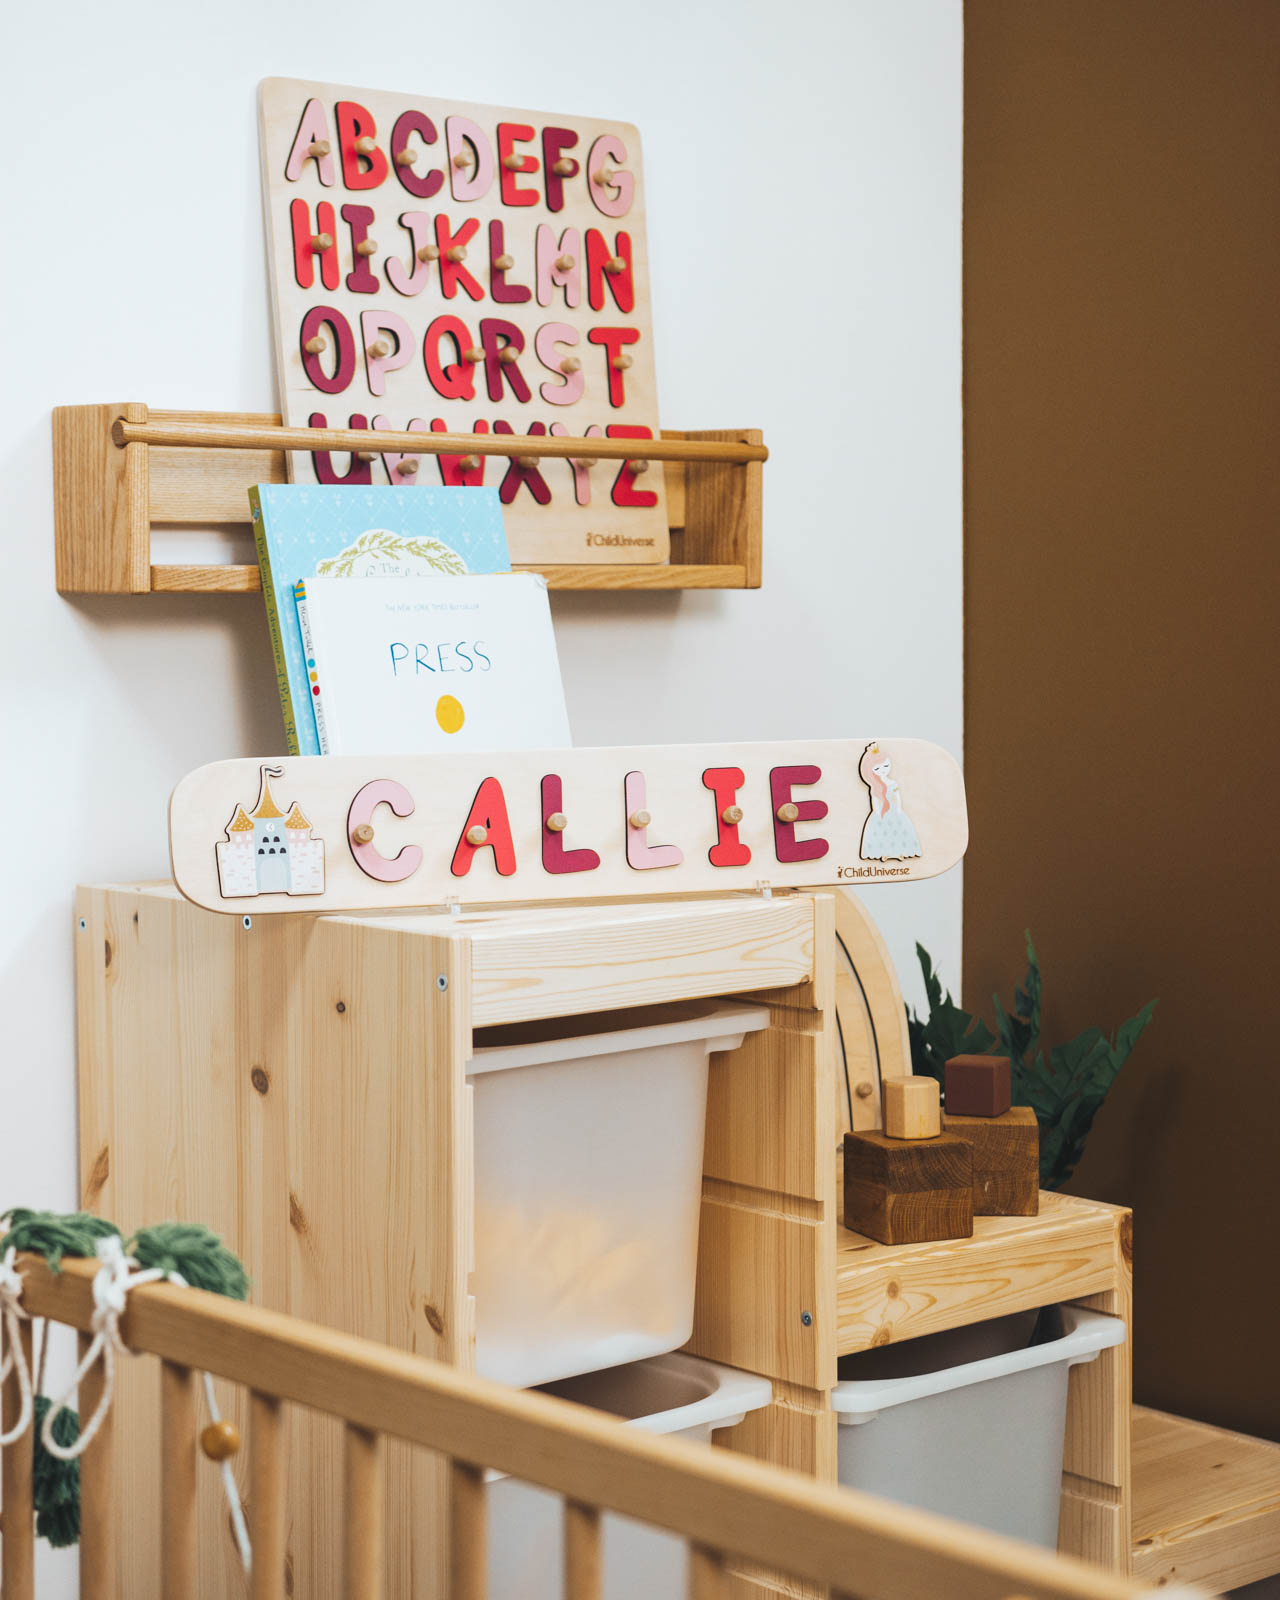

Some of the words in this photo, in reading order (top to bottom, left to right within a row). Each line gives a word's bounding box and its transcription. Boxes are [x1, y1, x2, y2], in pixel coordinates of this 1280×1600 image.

[268, 607, 281, 665] Adventures
[390, 640, 491, 677] PRESS
[346, 763, 830, 883] CALLIE
[844, 866, 911, 878] ChildUniverse
